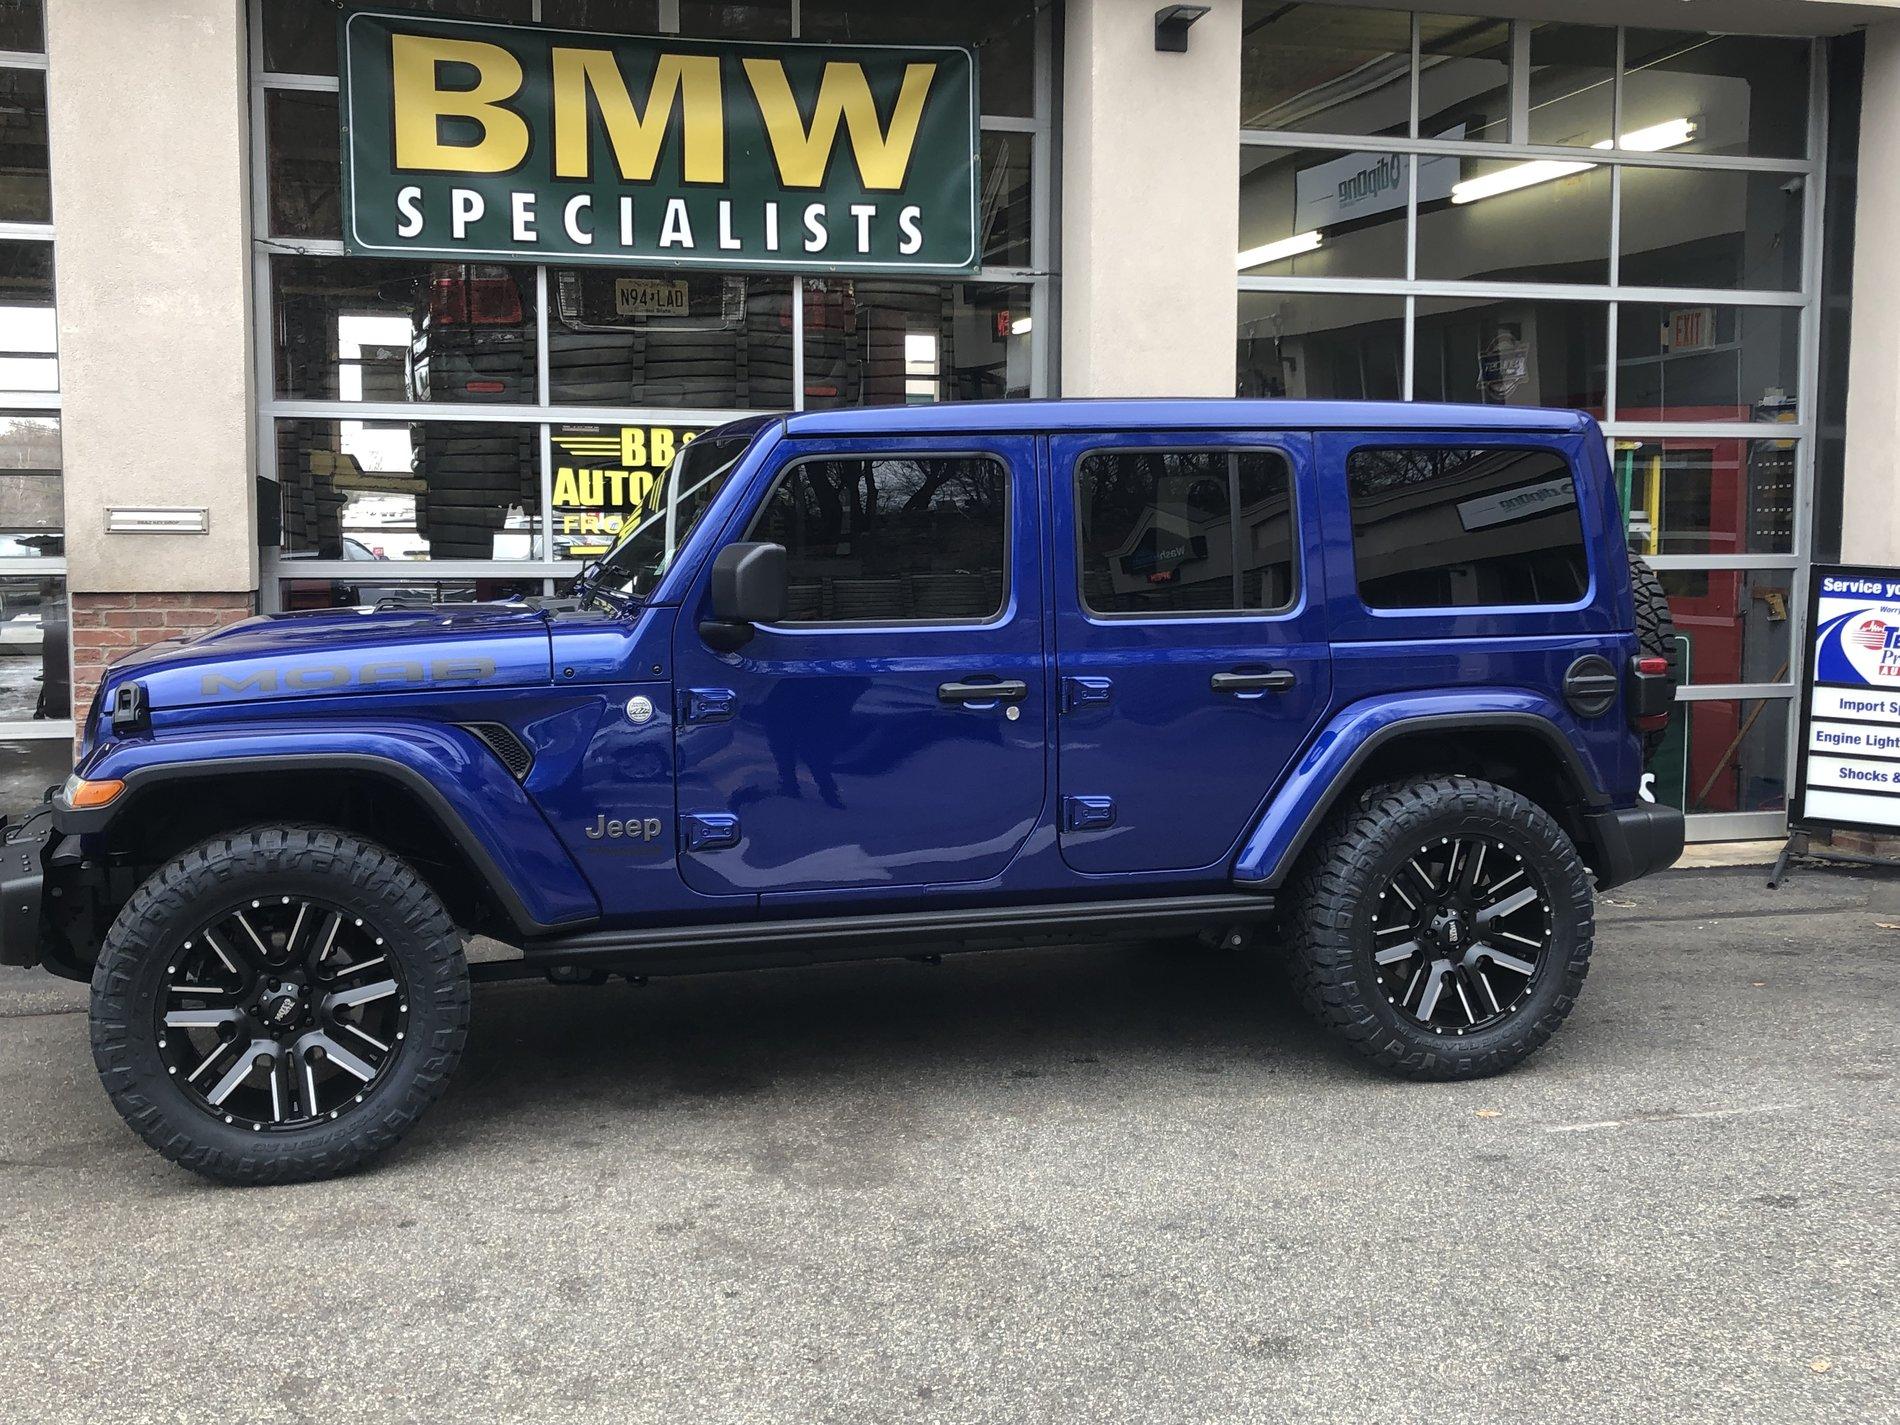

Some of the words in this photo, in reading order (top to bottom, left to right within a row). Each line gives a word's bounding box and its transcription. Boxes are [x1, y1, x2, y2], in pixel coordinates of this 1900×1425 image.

[391, 33, 937, 189] BMW
[396, 186, 923, 255] SPECIALISTS
[621, 427, 675, 467] BB
[552, 467, 653, 506] AUTO
[1823, 577, 1882, 595] Service
[202, 657, 497, 695] MOAB
[1839, 698, 1885, 713] Import
[1889, 701, 1900, 717] S
[1816, 730, 1862, 746] Engine
[1839, 767, 1888, 783] Shocks
[585, 814, 662, 842] Jeep
